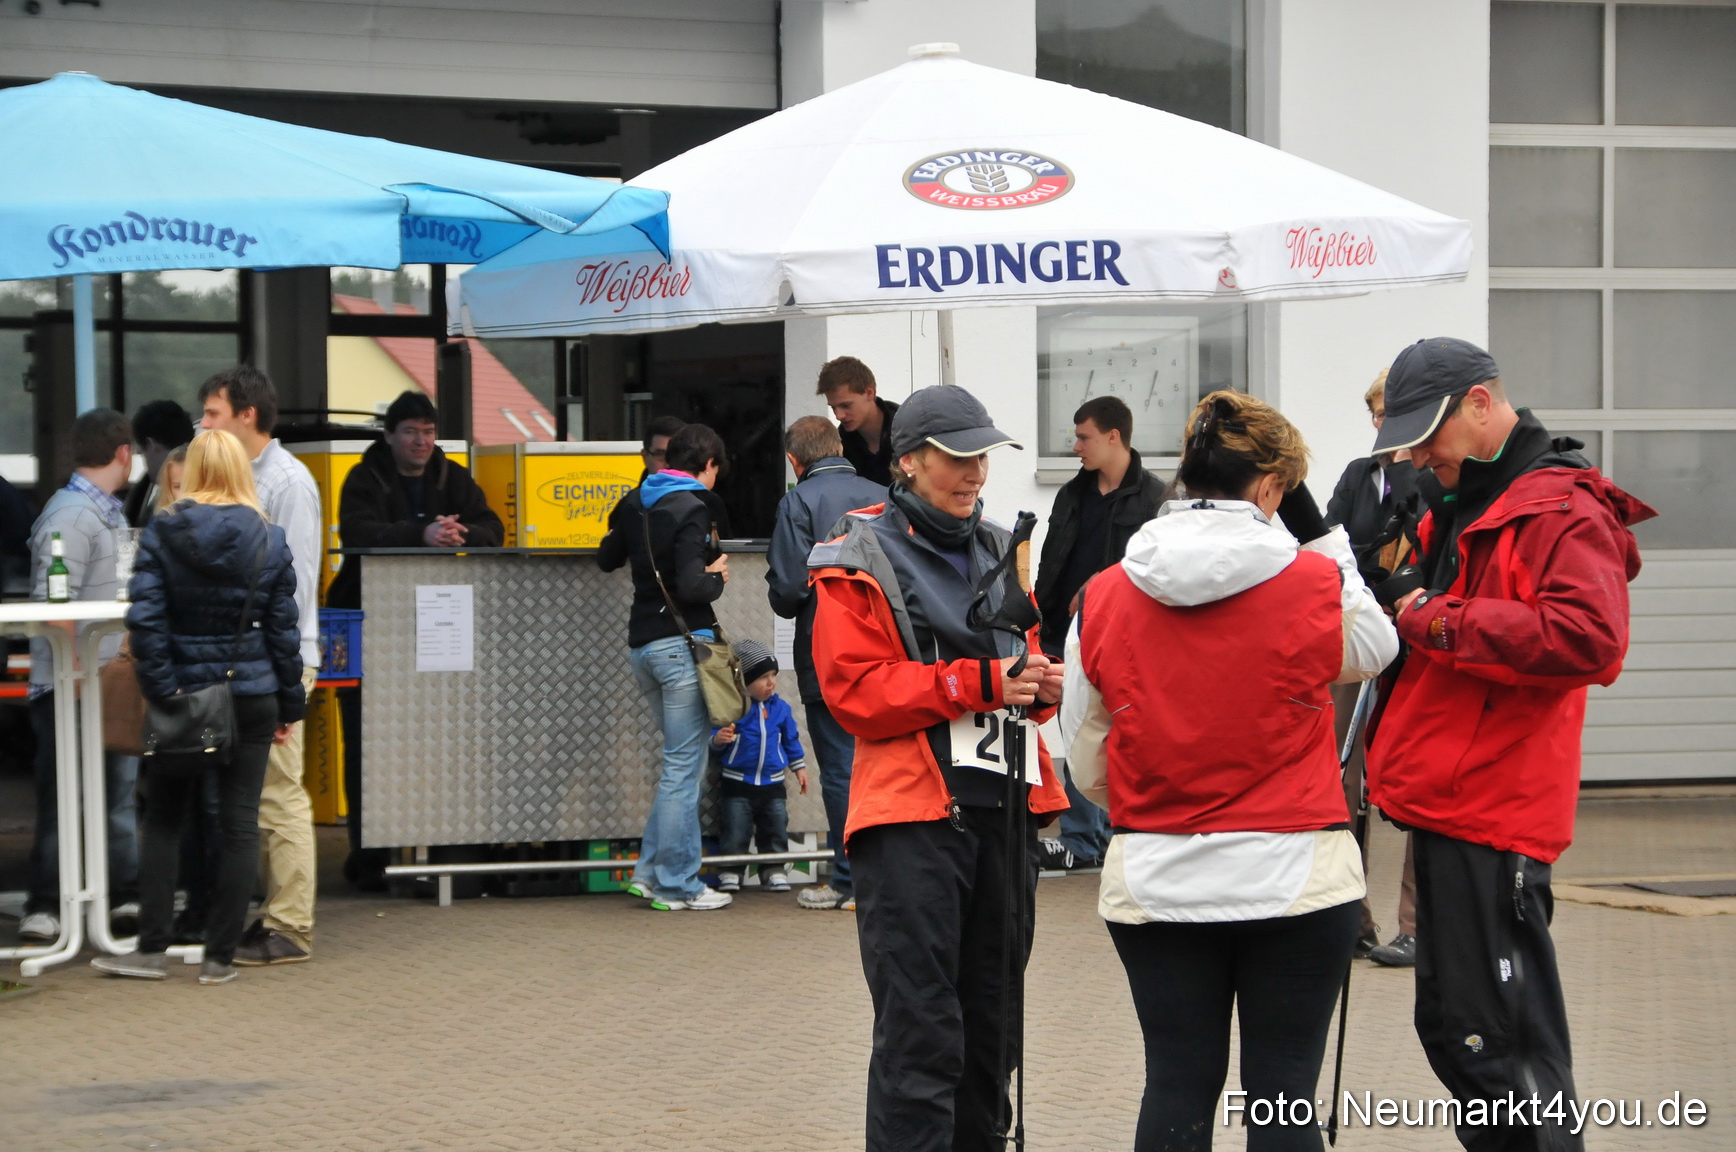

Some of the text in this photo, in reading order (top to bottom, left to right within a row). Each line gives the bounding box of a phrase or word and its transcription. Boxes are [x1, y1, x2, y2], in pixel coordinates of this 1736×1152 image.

[912, 151, 1055, 179] ERDINGER
[929, 184, 1060, 206] WEISSBRÄU
[47, 210, 257, 269] Kondrauer
[97, 252, 215, 264] MINERALWASSER
[874, 239, 1131, 293] ERDINGER
[1285, 226, 1378, 279] Weißbier
[575, 260, 693, 313] Weißbier
